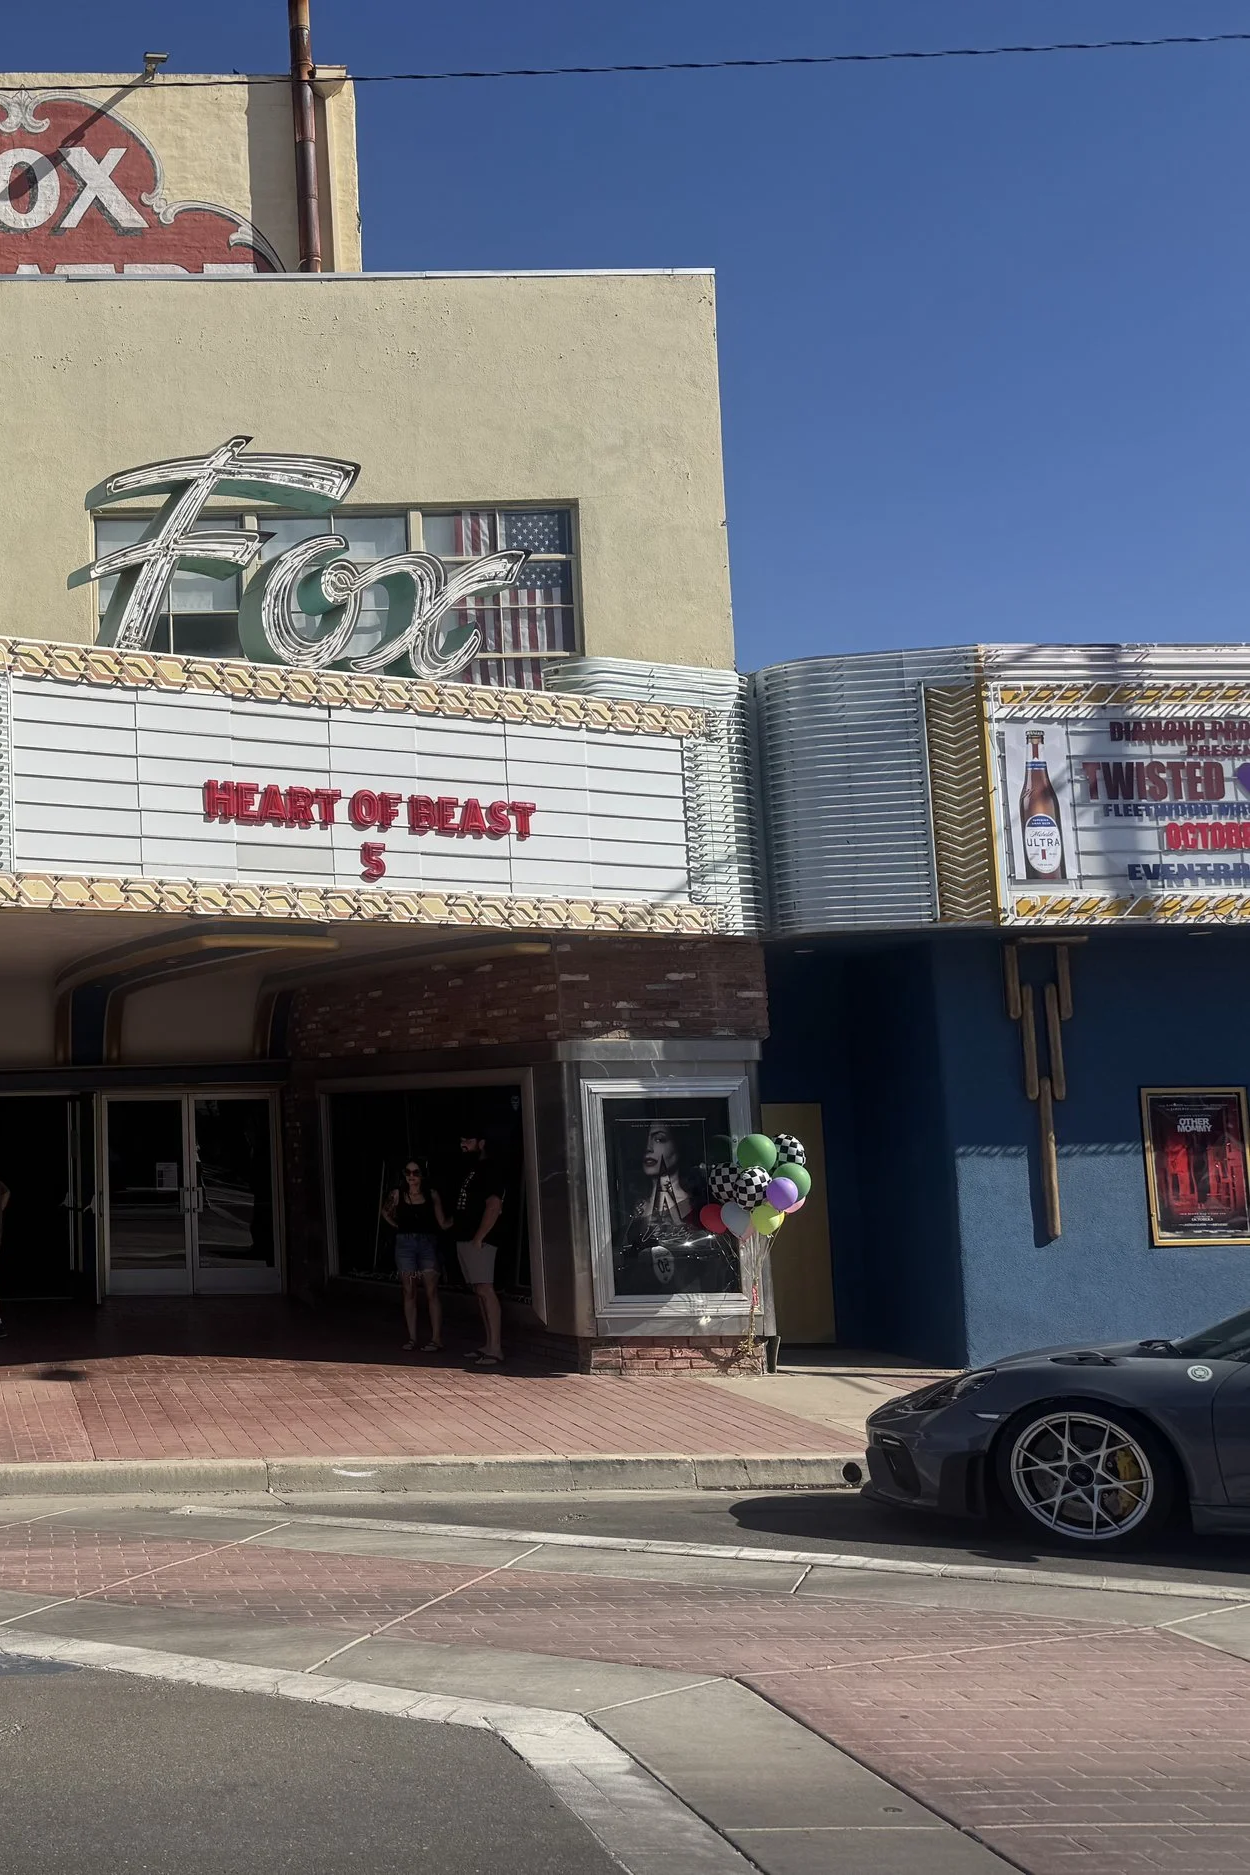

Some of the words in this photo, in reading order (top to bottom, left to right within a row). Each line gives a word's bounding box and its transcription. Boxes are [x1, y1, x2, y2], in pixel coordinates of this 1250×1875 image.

[67, 434, 533, 681] Fox
[1110, 721, 1206, 741] DIAMOND
[1082, 760, 1226, 801] TWISTED
[203, 779, 342, 825] HEART
[350, 789, 403, 829] OF
[409, 793, 537, 838] BEAST
[1103, 803, 1213, 817] FLEETWOOD
[1026, 838, 1061, 847] ULTRA
[360, 841, 386, 880] 5
[1176, 1124, 1213, 1132] MOMMY
[1178, 1117, 1210, 1126] OTHER
[641, 1222, 694, 1243] Verity
